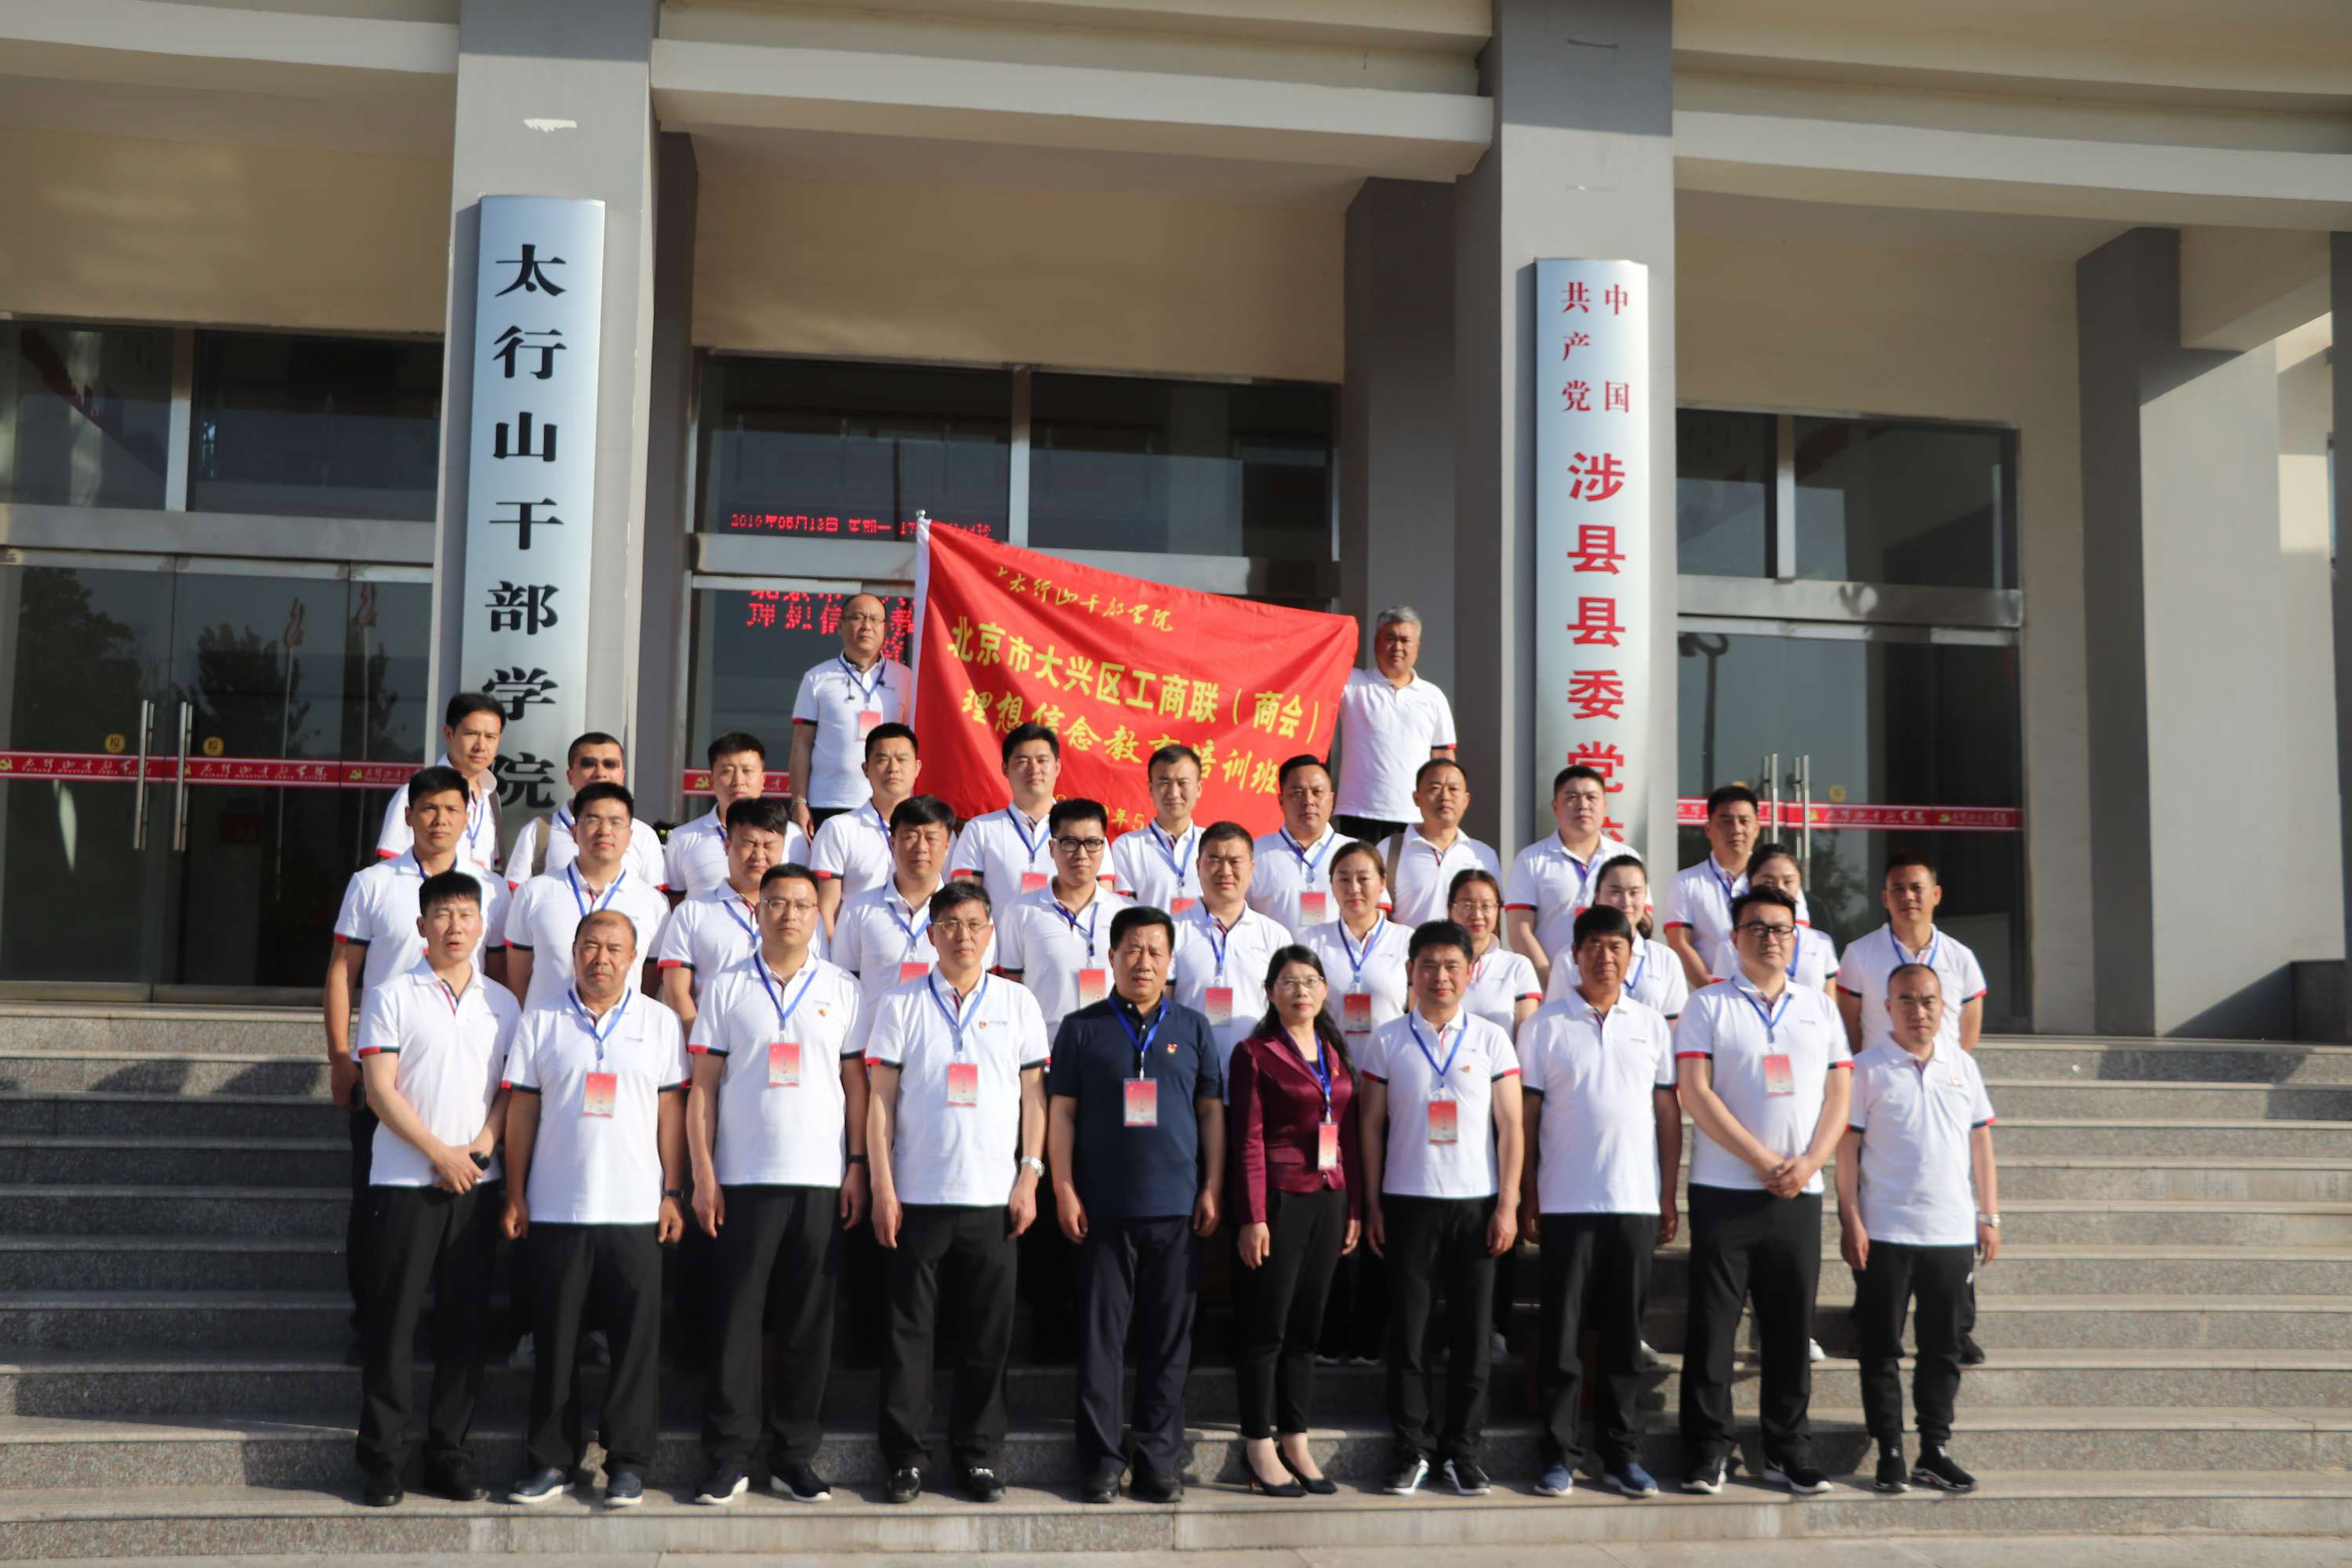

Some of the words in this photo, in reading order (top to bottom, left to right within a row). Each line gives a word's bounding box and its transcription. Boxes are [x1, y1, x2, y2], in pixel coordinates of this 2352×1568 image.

[482, 244, 567, 809] 太行山干部学院
[1567, 452, 1625, 843] 涉县县委党
